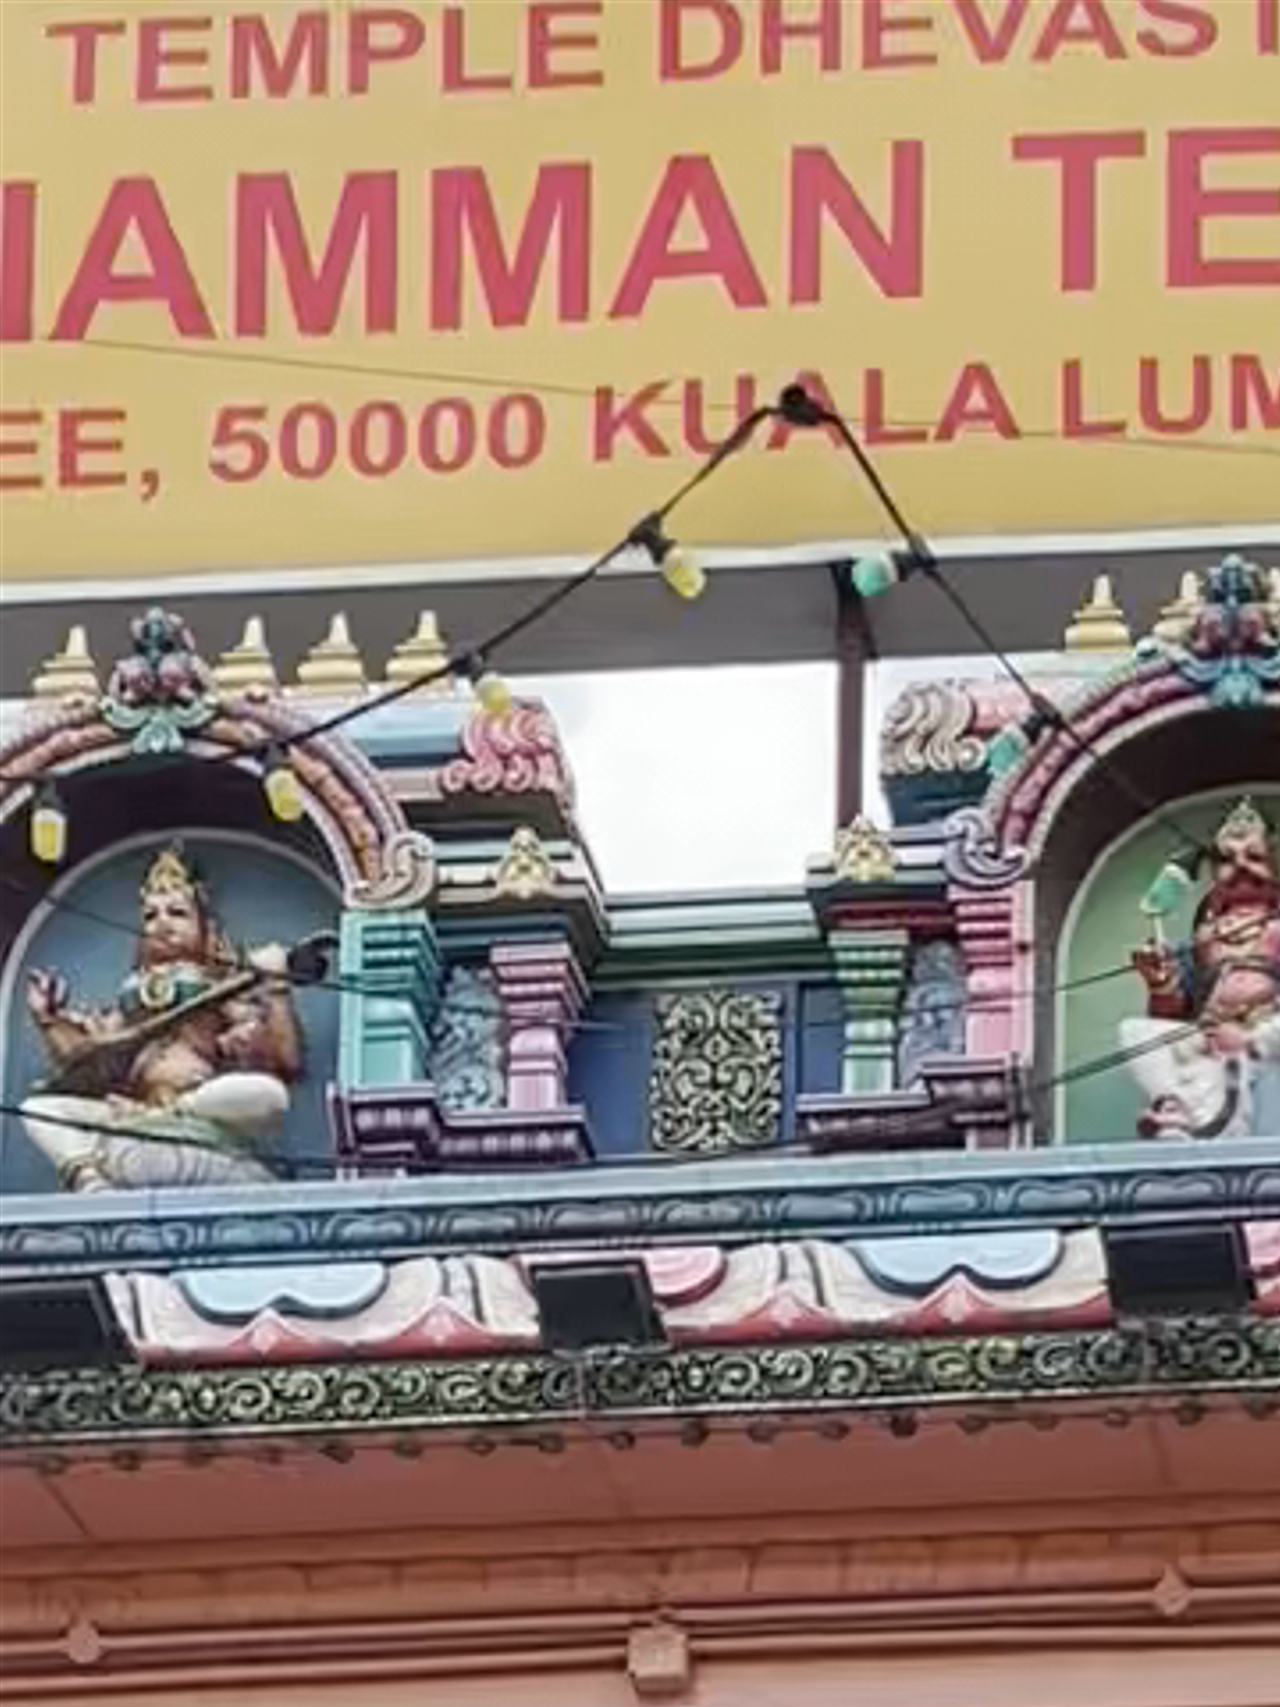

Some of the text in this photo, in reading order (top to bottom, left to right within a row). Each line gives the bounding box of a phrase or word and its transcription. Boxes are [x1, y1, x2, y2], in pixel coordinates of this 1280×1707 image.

[46, 1, 604, 104] TEMPLE
[210, 394, 546, 483] 50000
[593, 362, 1021, 464] KUALA
